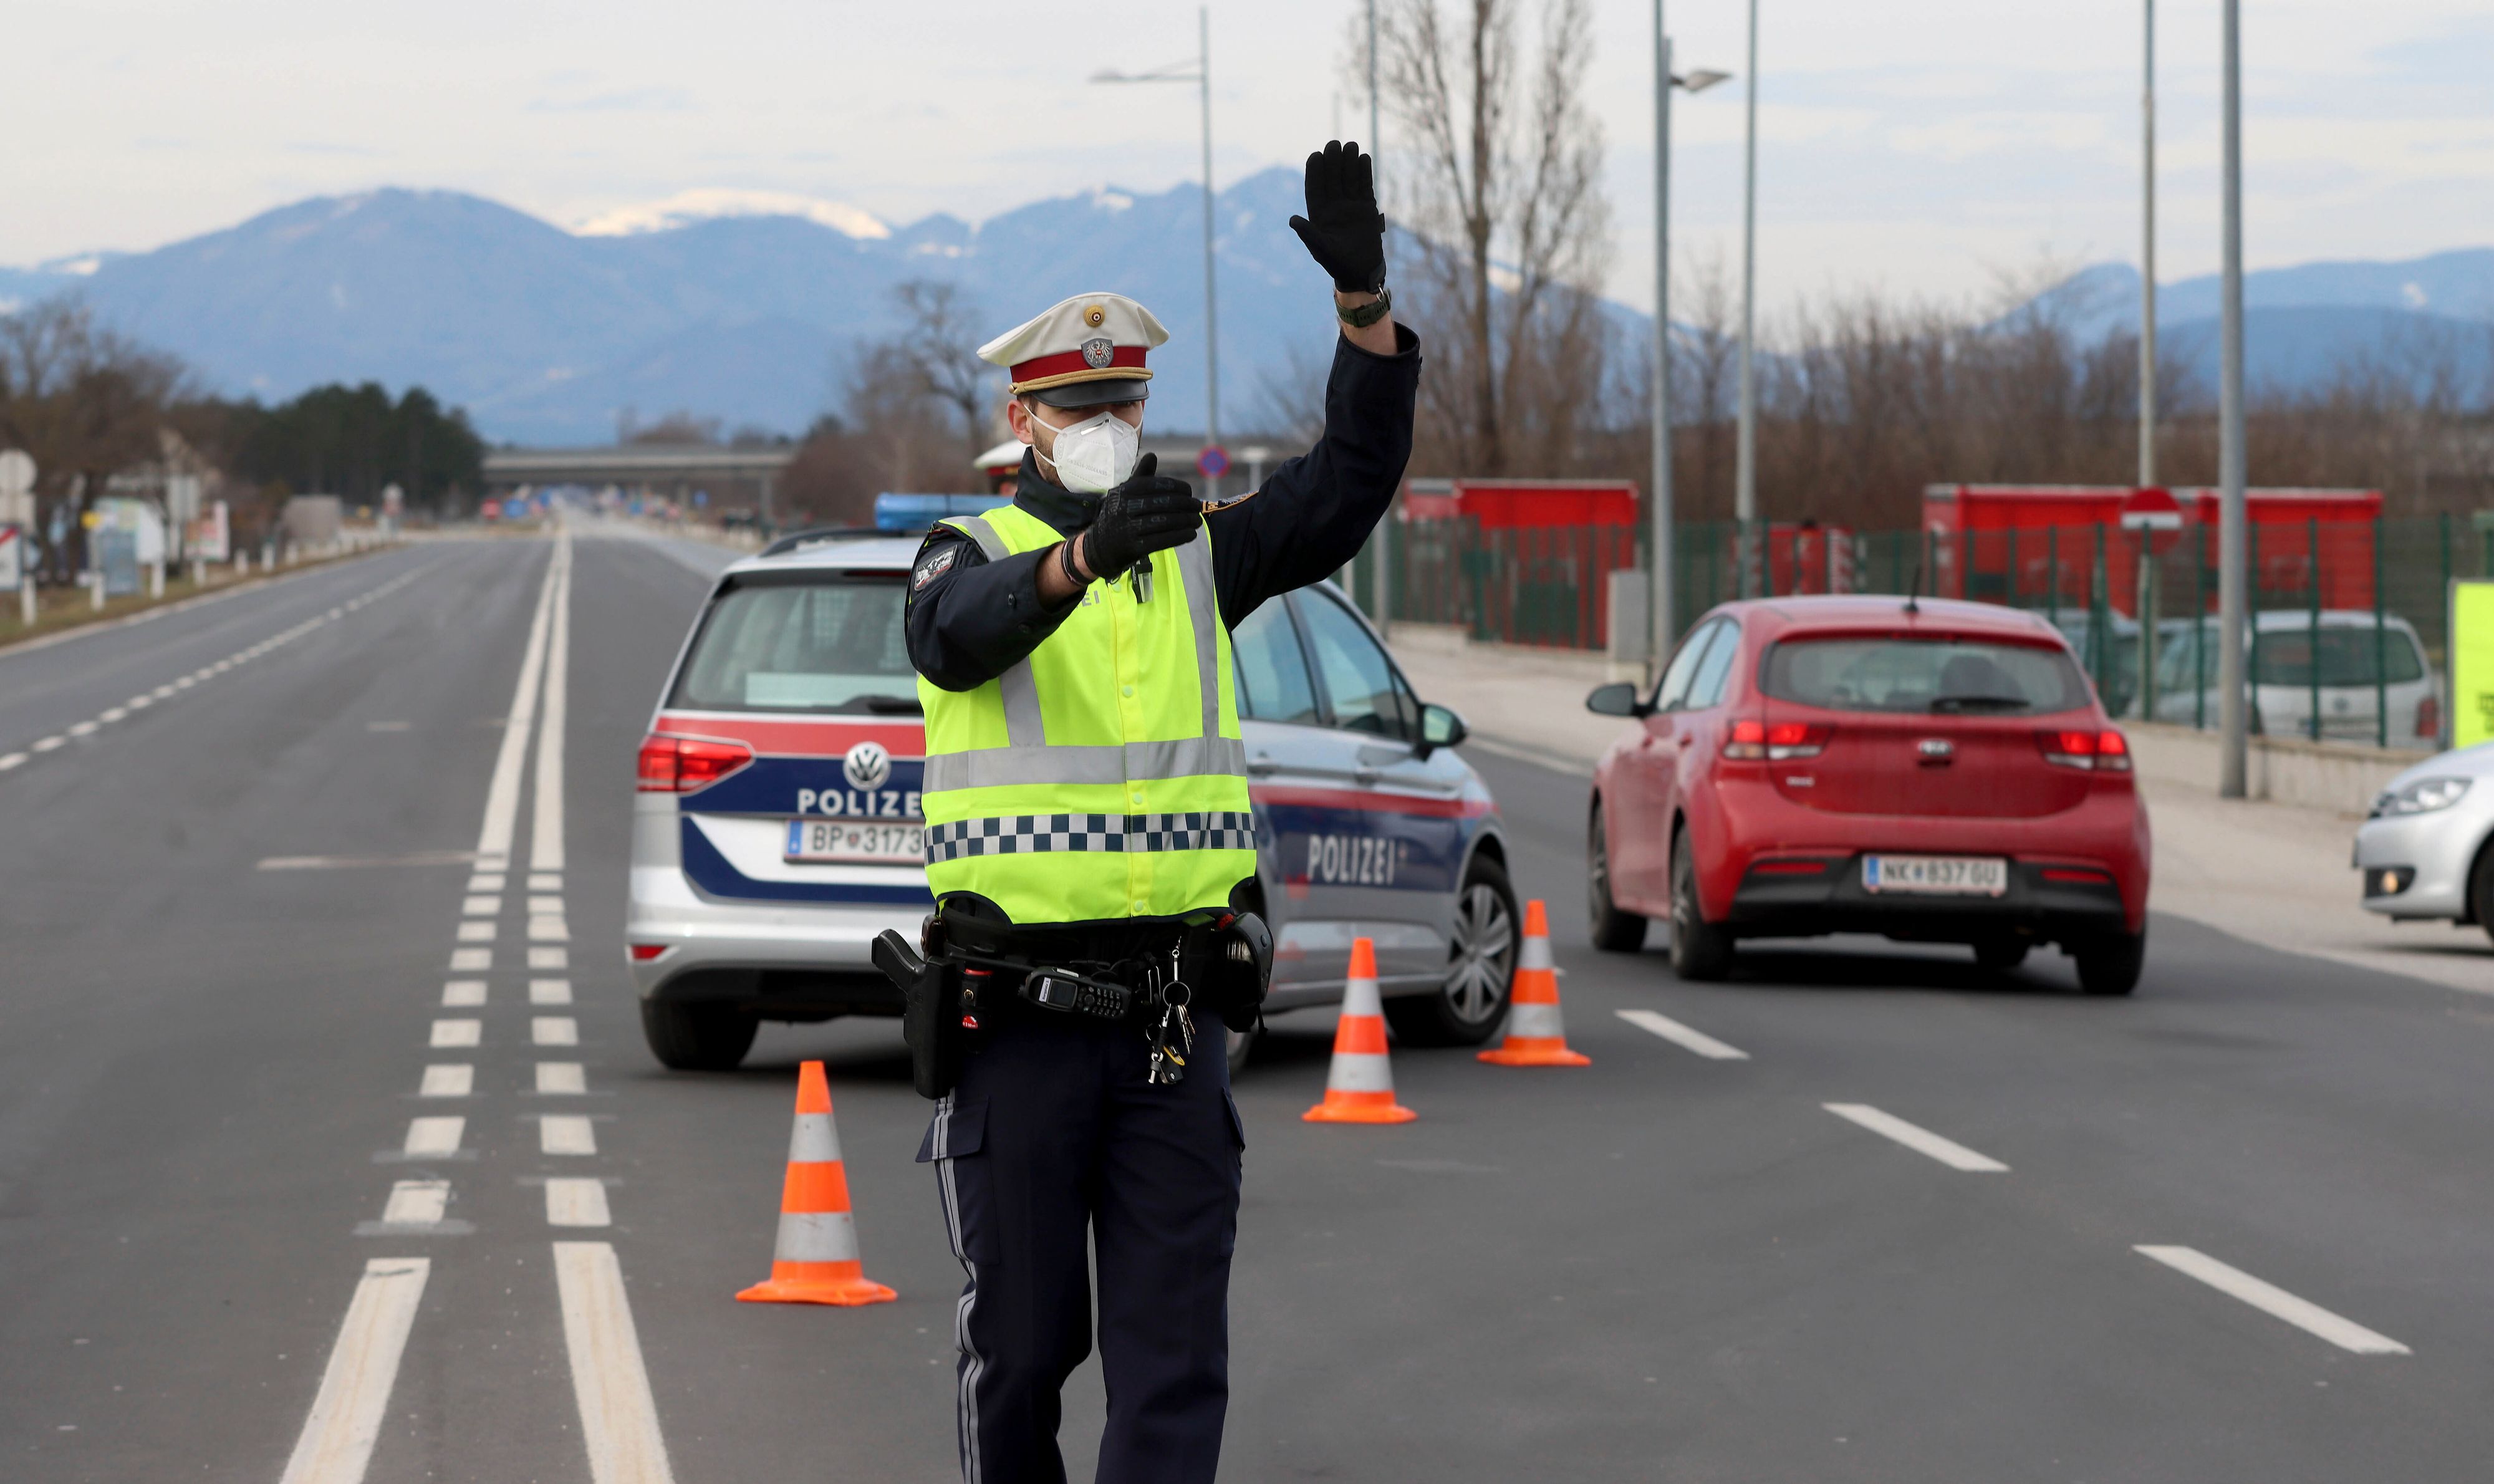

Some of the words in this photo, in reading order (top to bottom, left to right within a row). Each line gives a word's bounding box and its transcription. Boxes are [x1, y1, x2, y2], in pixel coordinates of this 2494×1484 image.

[797, 788, 922, 817] POLIZE
[812, 824, 843, 851] BP
[863, 827, 923, 854] 3173
[1307, 834, 1395, 885] POLIZEI
